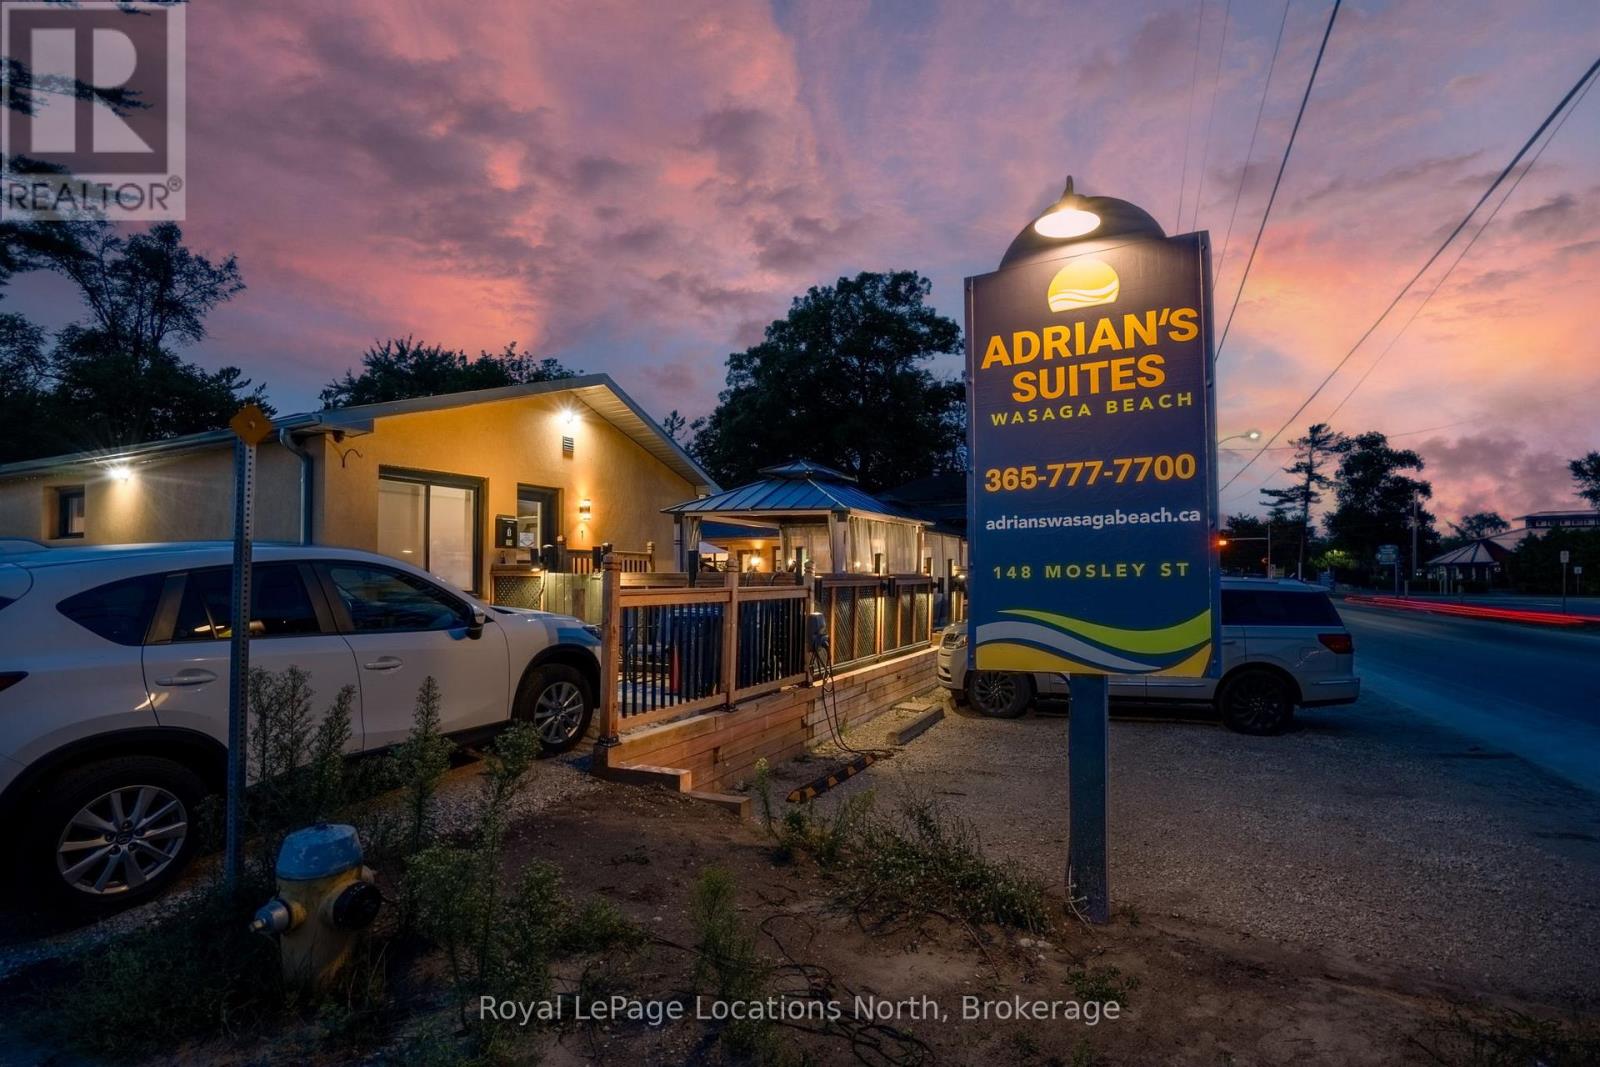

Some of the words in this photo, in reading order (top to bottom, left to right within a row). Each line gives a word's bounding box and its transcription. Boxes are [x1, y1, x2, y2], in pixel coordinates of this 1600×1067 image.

[1012, 354, 1165, 402] SUITES
[991, 404, 1092, 426] WASAGA
[1105, 392, 1193, 415] BEACH
[985, 454, 1195, 492] 365-777-7700
[986, 508, 1200, 531] adrianswasagabeach.ca
[993, 565, 1032, 580] 148
[1045, 563, 1146, 579] MOSLEY
[1160, 562, 1190, 577] ST
